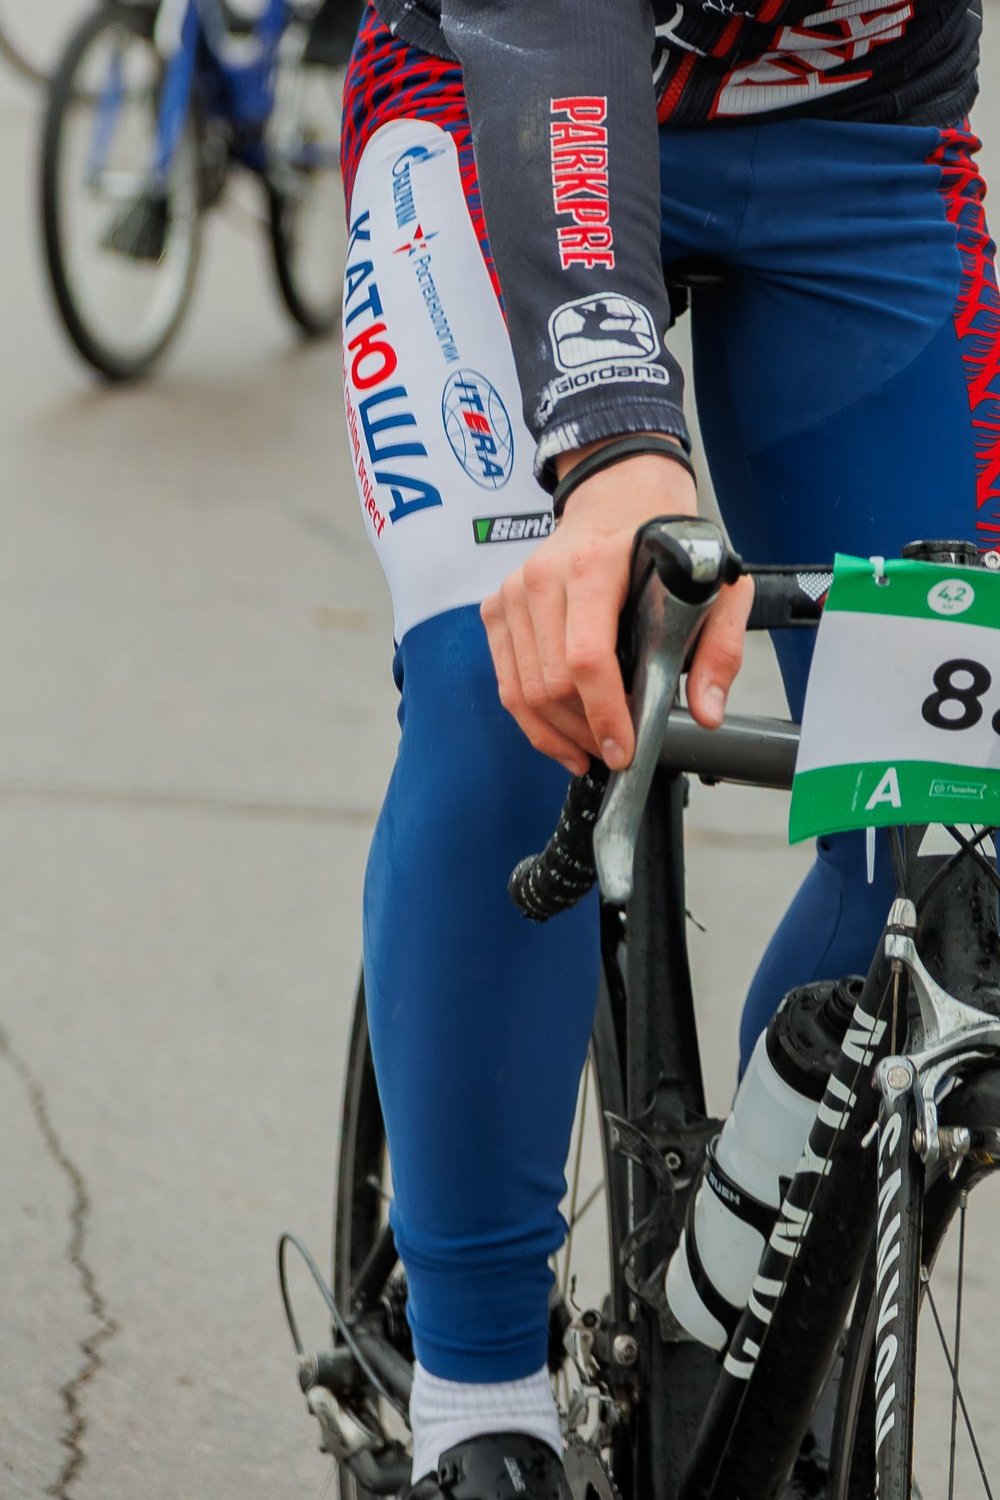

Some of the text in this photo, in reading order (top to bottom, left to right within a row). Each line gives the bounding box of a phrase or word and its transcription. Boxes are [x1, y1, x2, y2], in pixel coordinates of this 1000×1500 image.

[549, 95, 615, 271] PARKPRE
[344, 209, 444, 525] КАТЮША
[453, 380, 505, 479] ITERA
